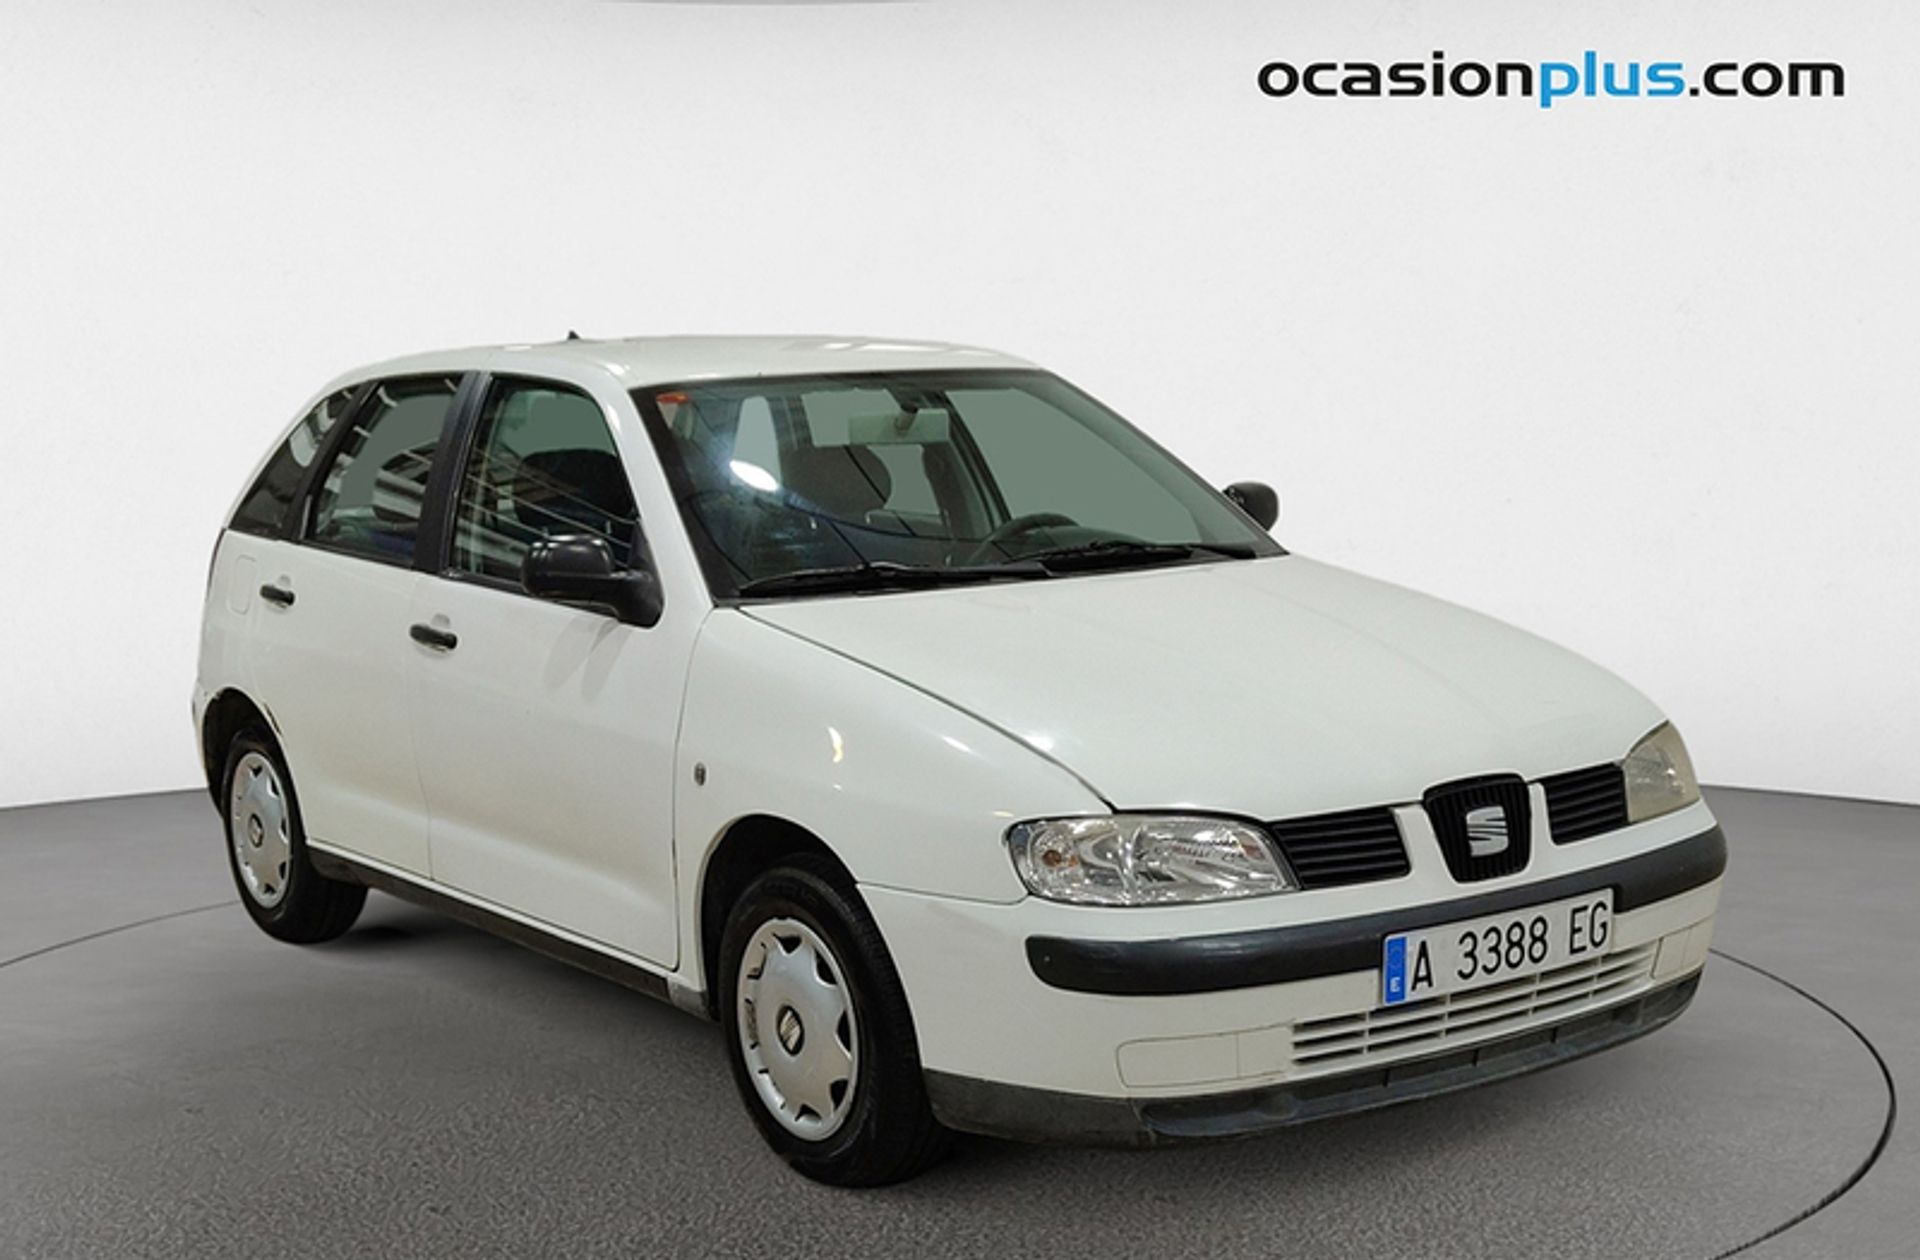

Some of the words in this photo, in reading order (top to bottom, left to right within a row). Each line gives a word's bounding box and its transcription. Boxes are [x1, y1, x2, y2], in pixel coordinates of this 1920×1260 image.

[1411, 939, 1434, 992] A
[1456, 915, 1549, 980] 3388
[1568, 900, 1609, 956] EG
